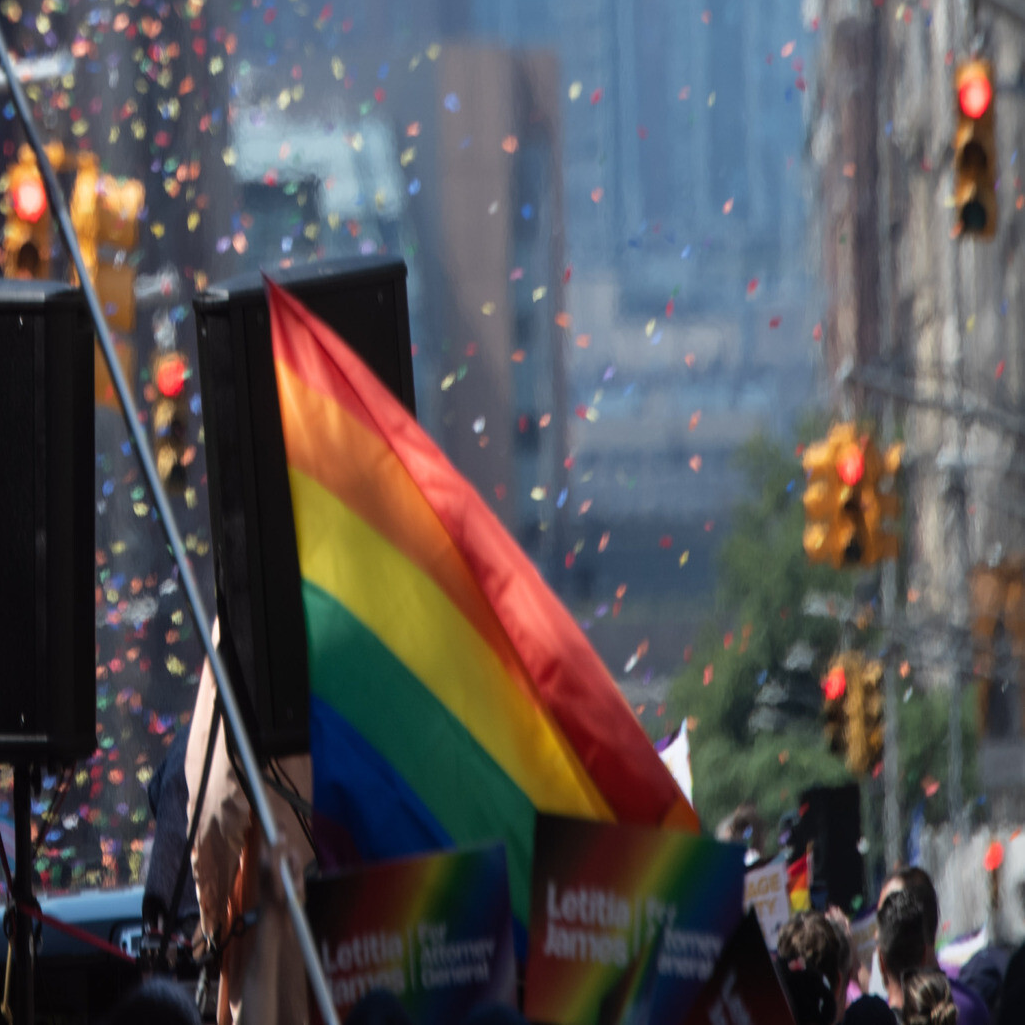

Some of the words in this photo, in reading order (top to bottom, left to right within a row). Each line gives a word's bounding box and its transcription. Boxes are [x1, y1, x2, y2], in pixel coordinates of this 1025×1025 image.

[547, 878, 631, 929] Letitia
[321, 930, 404, 974] Letitia
[420, 937, 496, 963] Attorney
[544, 920, 630, 970] James
[421, 959, 490, 989] General
[657, 955, 716, 982] eneral
